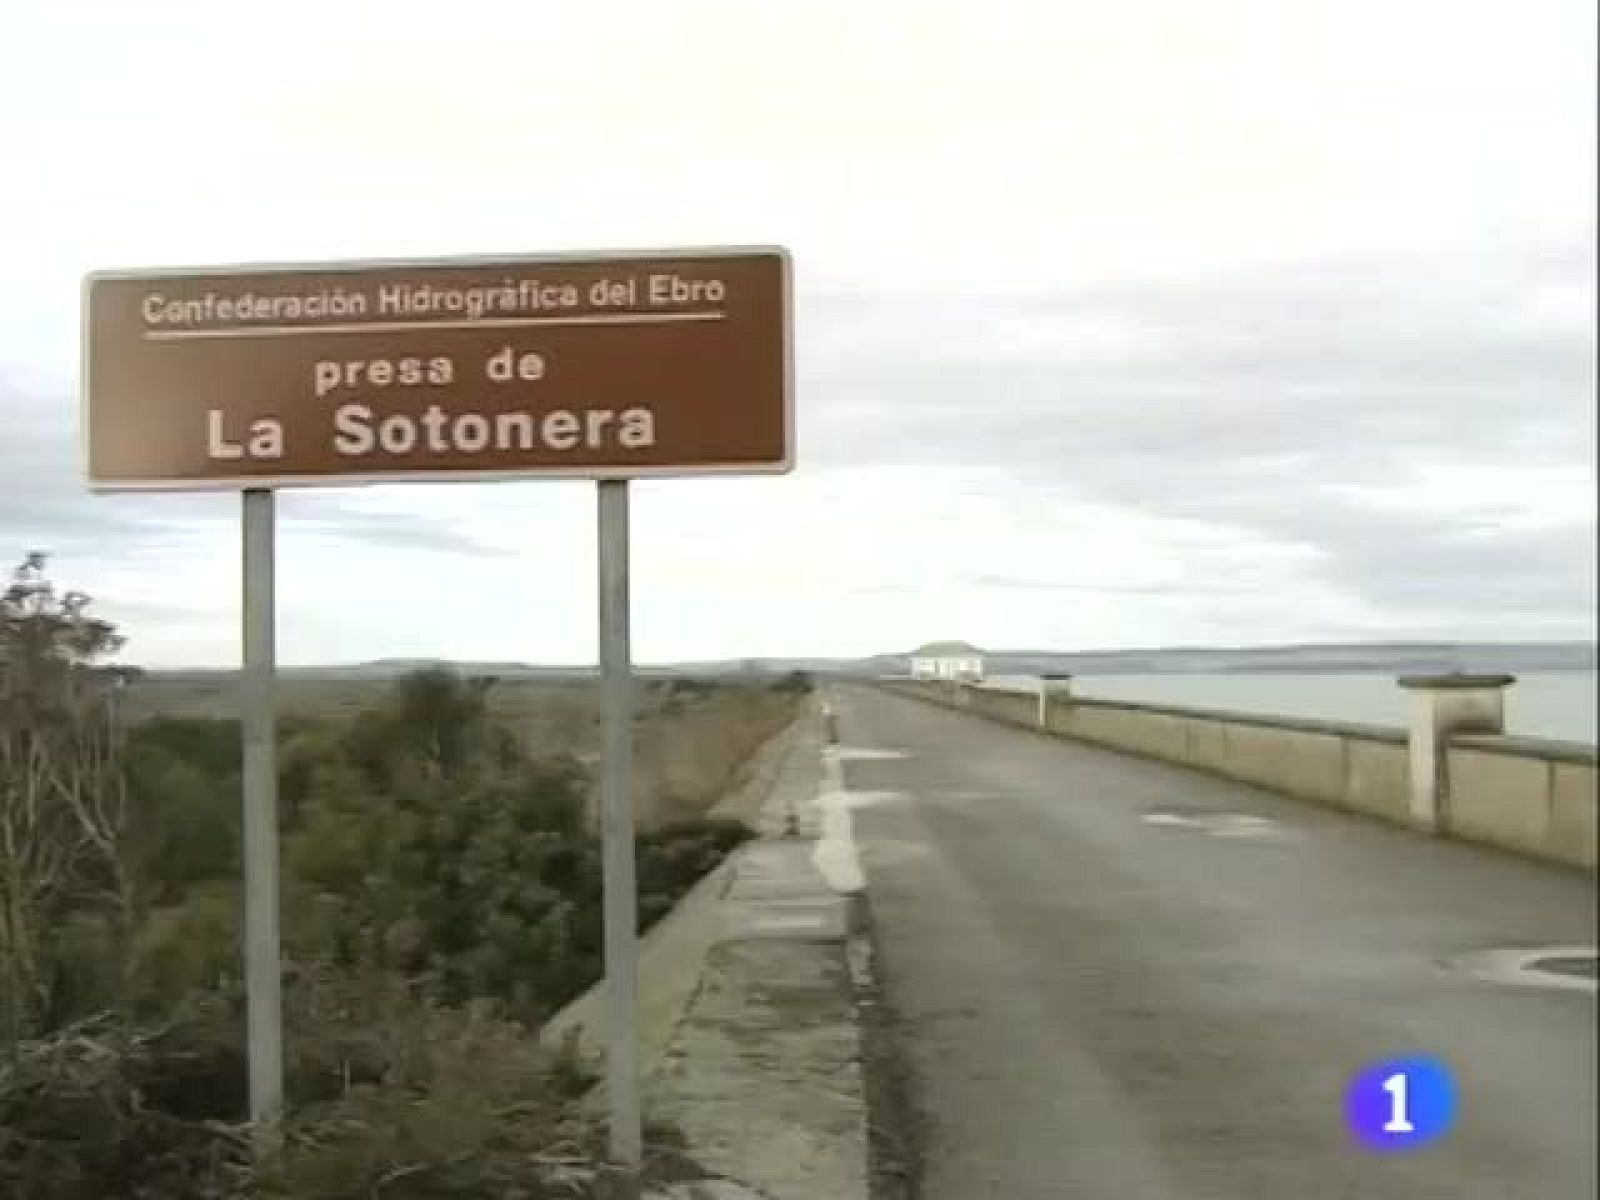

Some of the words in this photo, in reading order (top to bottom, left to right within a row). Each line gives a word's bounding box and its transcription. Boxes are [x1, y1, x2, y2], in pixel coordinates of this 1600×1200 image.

[142, 289, 367, 325] Confederación
[379, 280, 579, 319] Hidrográfica
[590, 278, 636, 307] del
[649, 273, 725, 302] Ebro
[315, 356, 453, 396] presa
[487, 346, 544, 382] de
[208, 409, 283, 458] La
[334, 405, 655, 455] Sotonera
